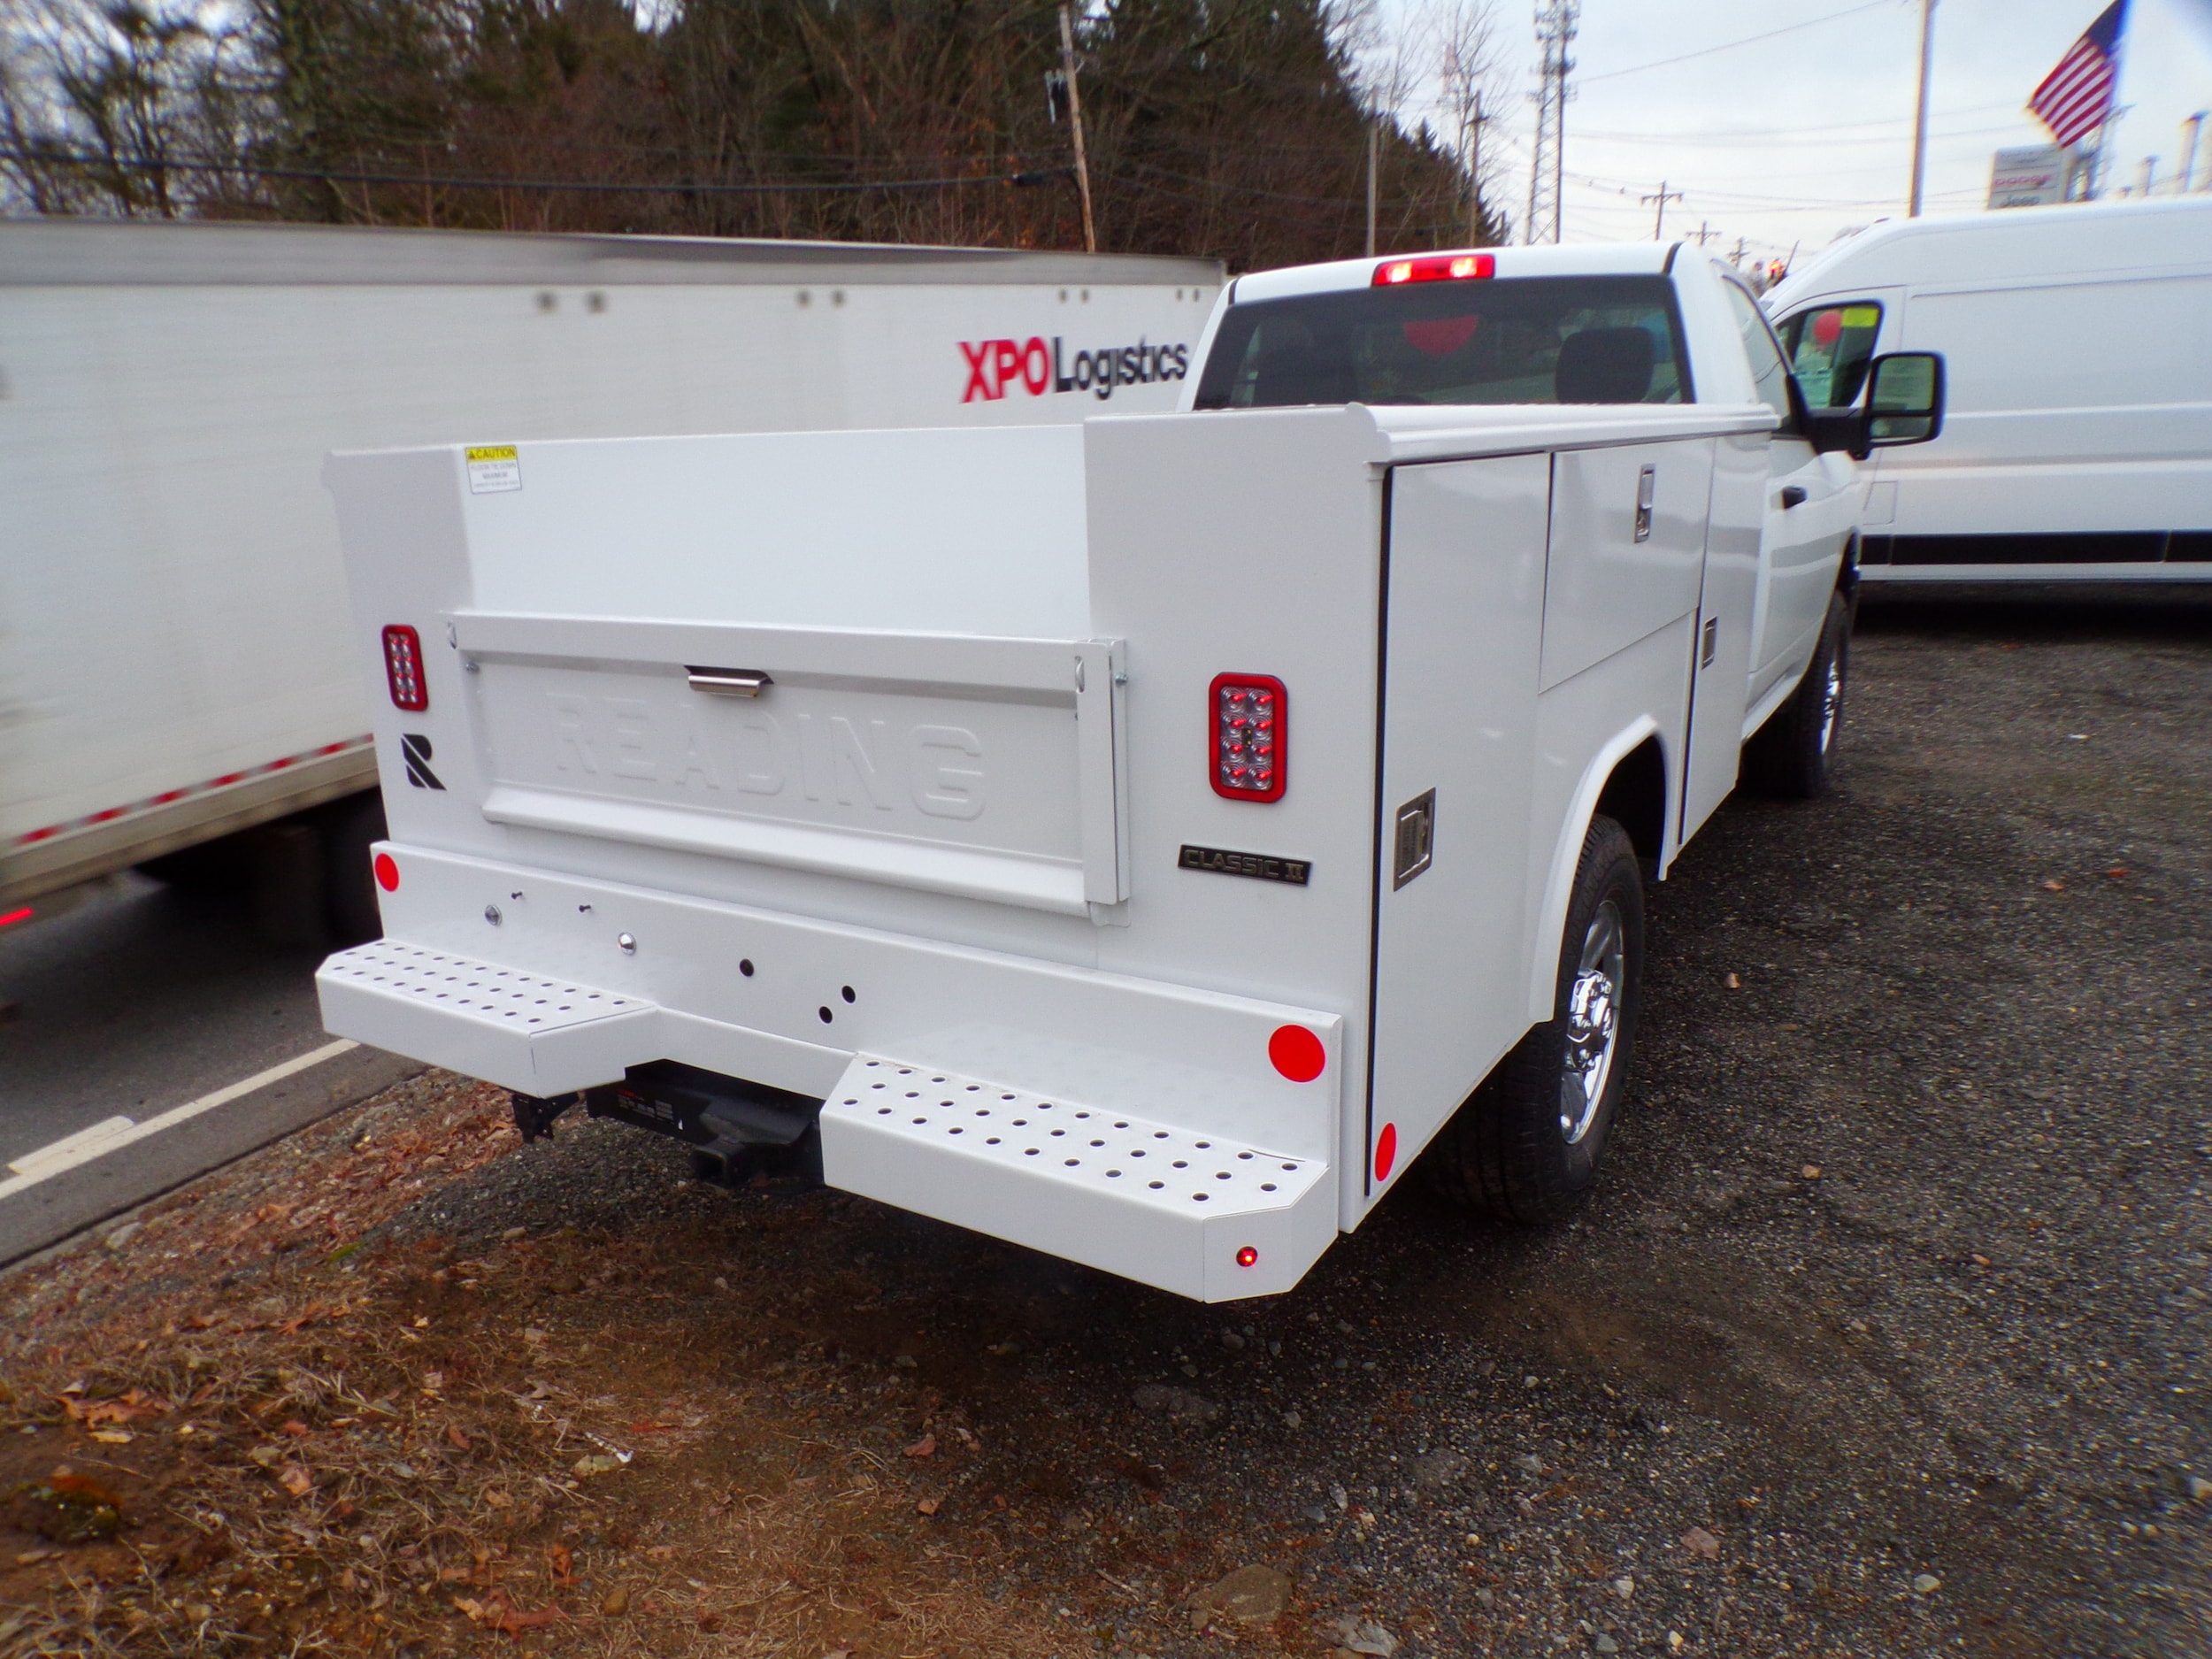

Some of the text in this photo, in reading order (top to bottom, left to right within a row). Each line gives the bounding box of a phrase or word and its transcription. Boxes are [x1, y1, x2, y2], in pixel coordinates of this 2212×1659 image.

[956, 334, 1188, 403] XPO Logistics
[476, 448, 516, 459] CAUTION
[544, 693, 987, 822] READING
[1184, 849, 1304, 880] CLASSIC II
